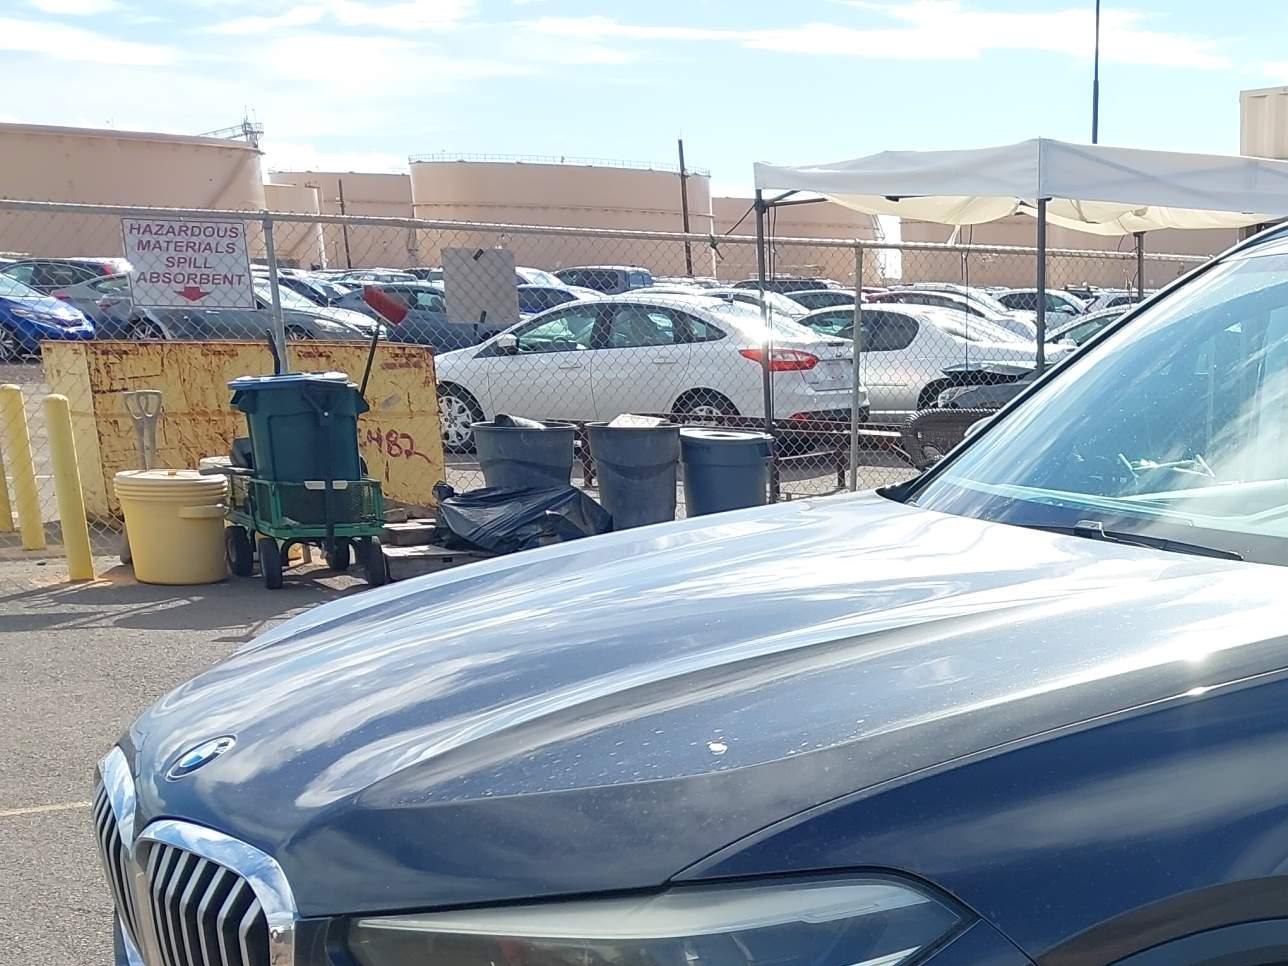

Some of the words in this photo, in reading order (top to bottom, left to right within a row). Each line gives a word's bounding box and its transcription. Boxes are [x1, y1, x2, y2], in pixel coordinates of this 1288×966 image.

[129, 223, 239, 239] HAZARDOUS
[137, 240, 236, 254] MATERIALS
[165, 256, 213, 269] SPILL
[136, 272, 245, 286] ABSORBENT
